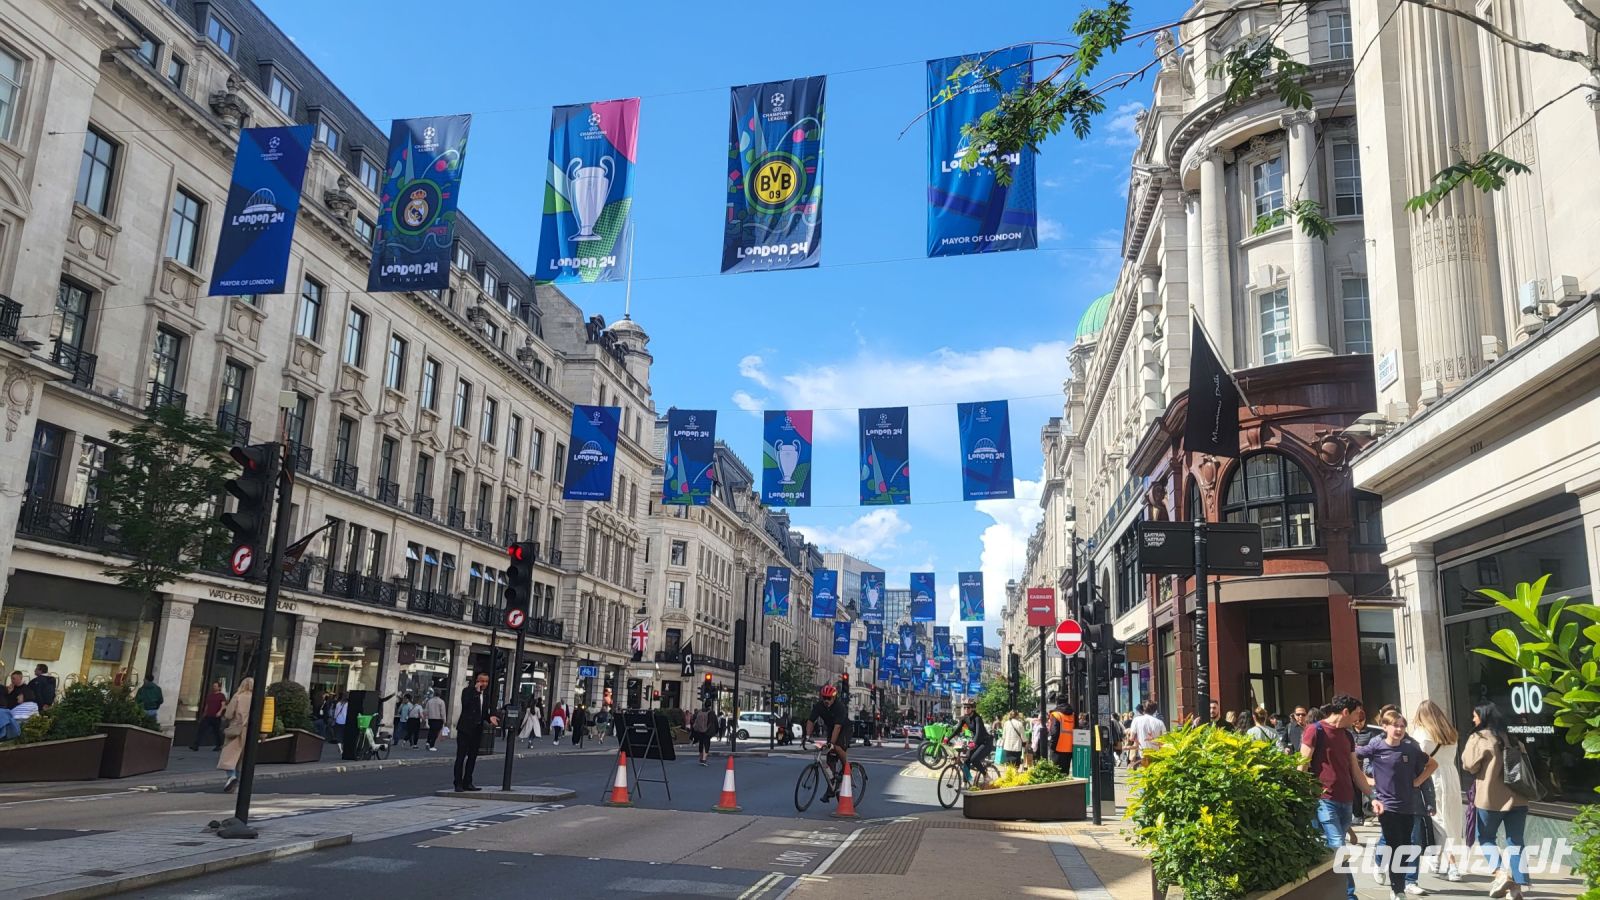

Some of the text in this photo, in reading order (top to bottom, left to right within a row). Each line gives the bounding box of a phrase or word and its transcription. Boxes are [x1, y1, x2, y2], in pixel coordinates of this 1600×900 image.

[761, 166, 792, 191] BVB
[270, 212, 285, 223] 24
[942, 236, 970, 245] MAYOR
[985, 232, 1022, 242] LONDON
[790, 242, 808, 255] 24
[424, 262, 438, 274] 24
[600, 256, 616, 267] 24
[209, 588, 244, 602] WATCHES
[1511, 668, 1543, 714] alo
